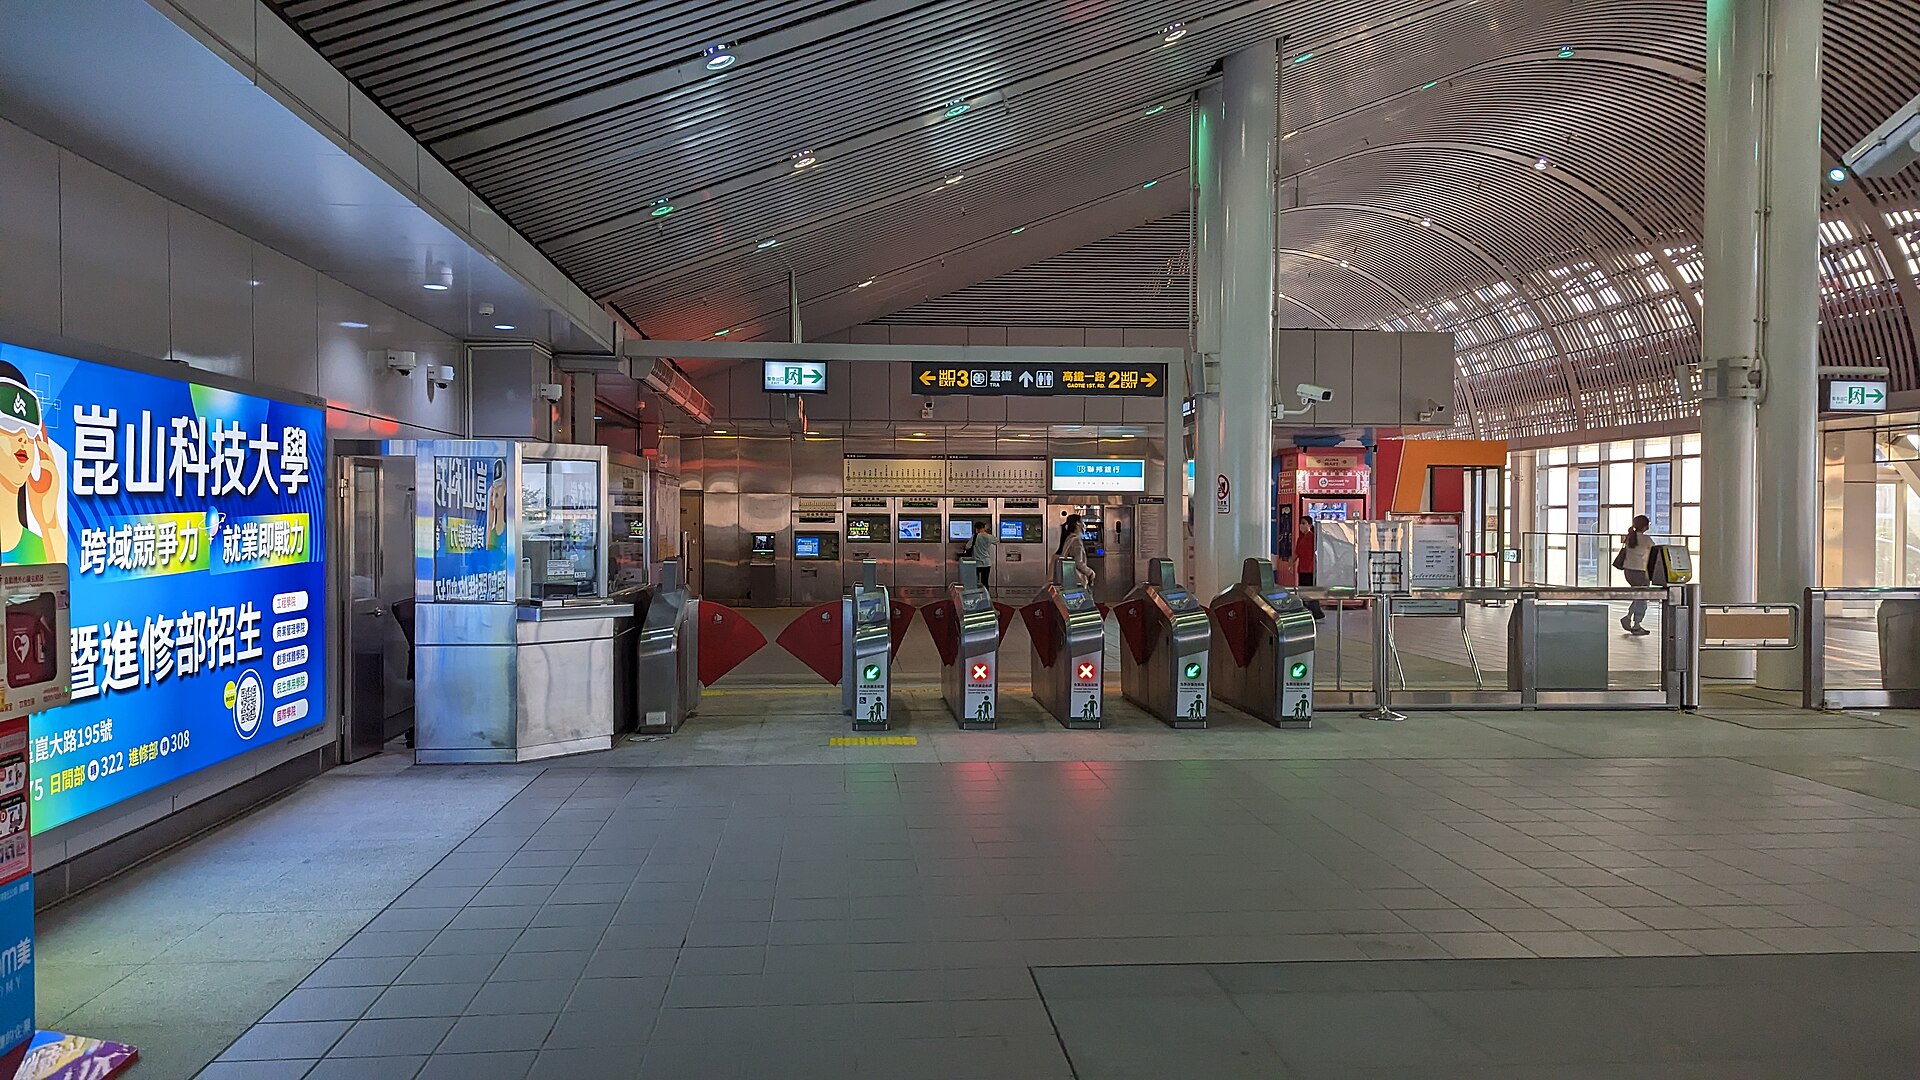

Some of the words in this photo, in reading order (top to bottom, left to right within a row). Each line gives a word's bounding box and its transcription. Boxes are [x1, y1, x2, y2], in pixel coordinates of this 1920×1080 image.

[939, 369, 956, 380] 出口
[957, 369, 969, 387] 3
[1062, 371, 1106, 382] 高鐵一路
[1108, 371, 1120, 388] 2
[1121, 371, 1138, 382] 出口
[73, 405, 309, 497] 崑山科技大學
[80, 520, 199, 576] 跨域競爭力
[222, 519, 305, 565] 就業即戰力
[71, 601, 263, 700] 暨進修部招生
[50, 764, 86, 795] 日間部
[101, 751, 124, 777] 322
[128, 741, 158, 767] 進修部
[171, 729, 190, 753] 308
